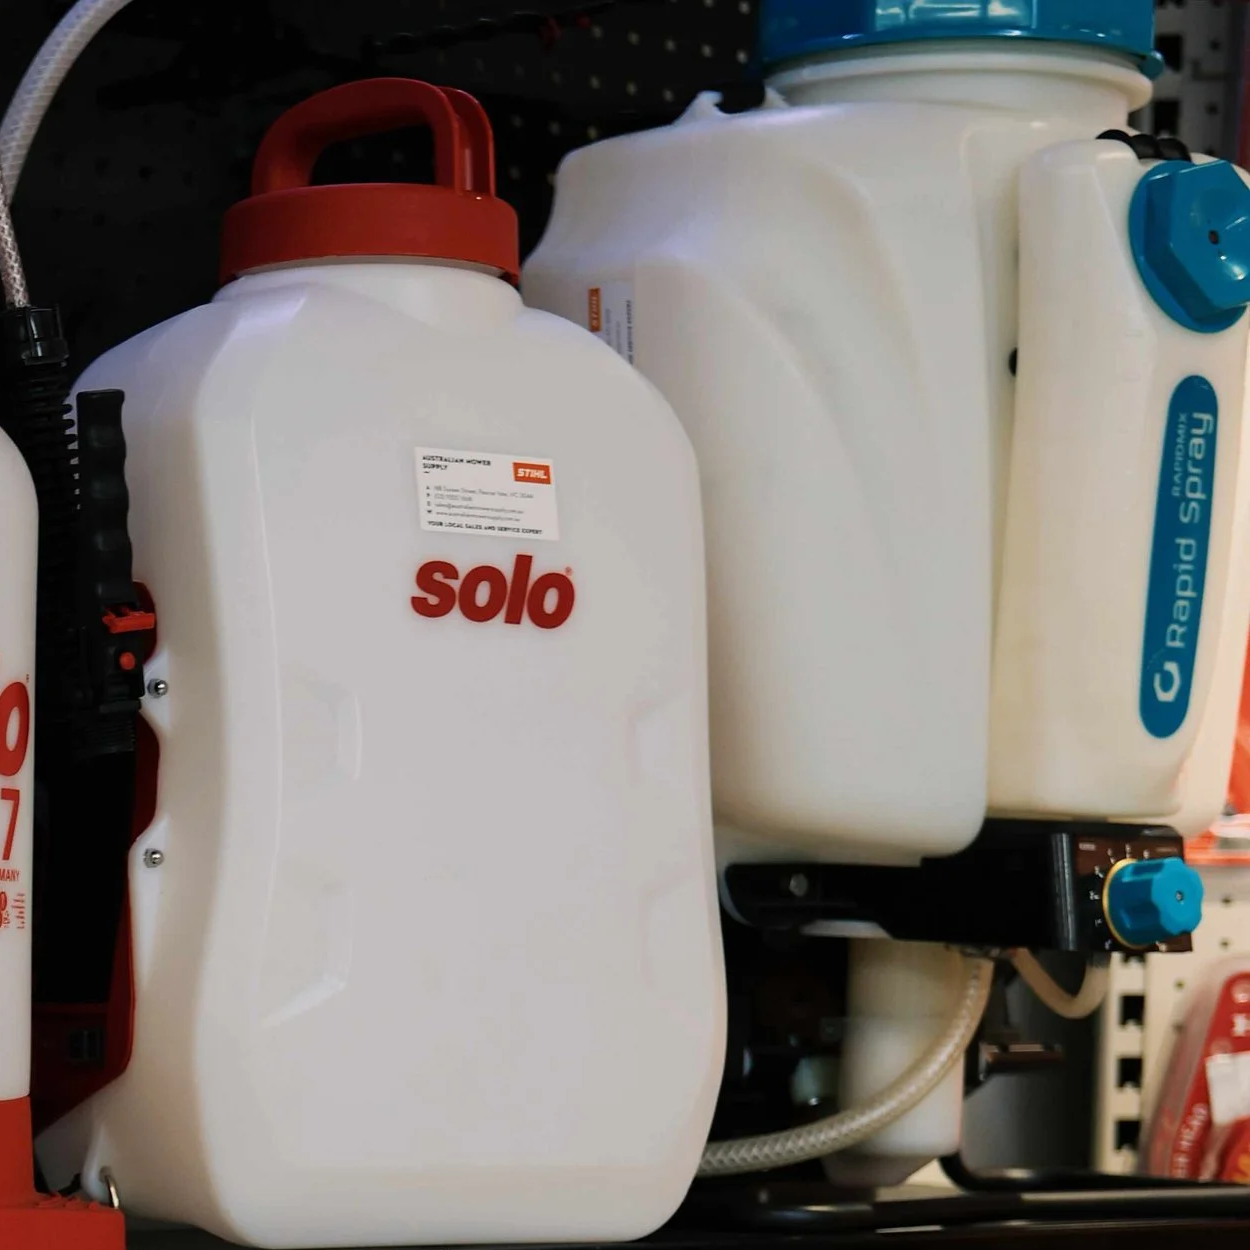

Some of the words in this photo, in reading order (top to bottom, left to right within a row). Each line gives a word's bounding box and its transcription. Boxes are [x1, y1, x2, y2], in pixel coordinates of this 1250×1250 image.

[517, 468, 548, 479] STIHL
[1170, 412, 1188, 497] RAPIDMIX
[1177, 411, 1215, 524] Spray
[411, 554, 575, 630] solo
[1165, 537, 1198, 649] Rapid
